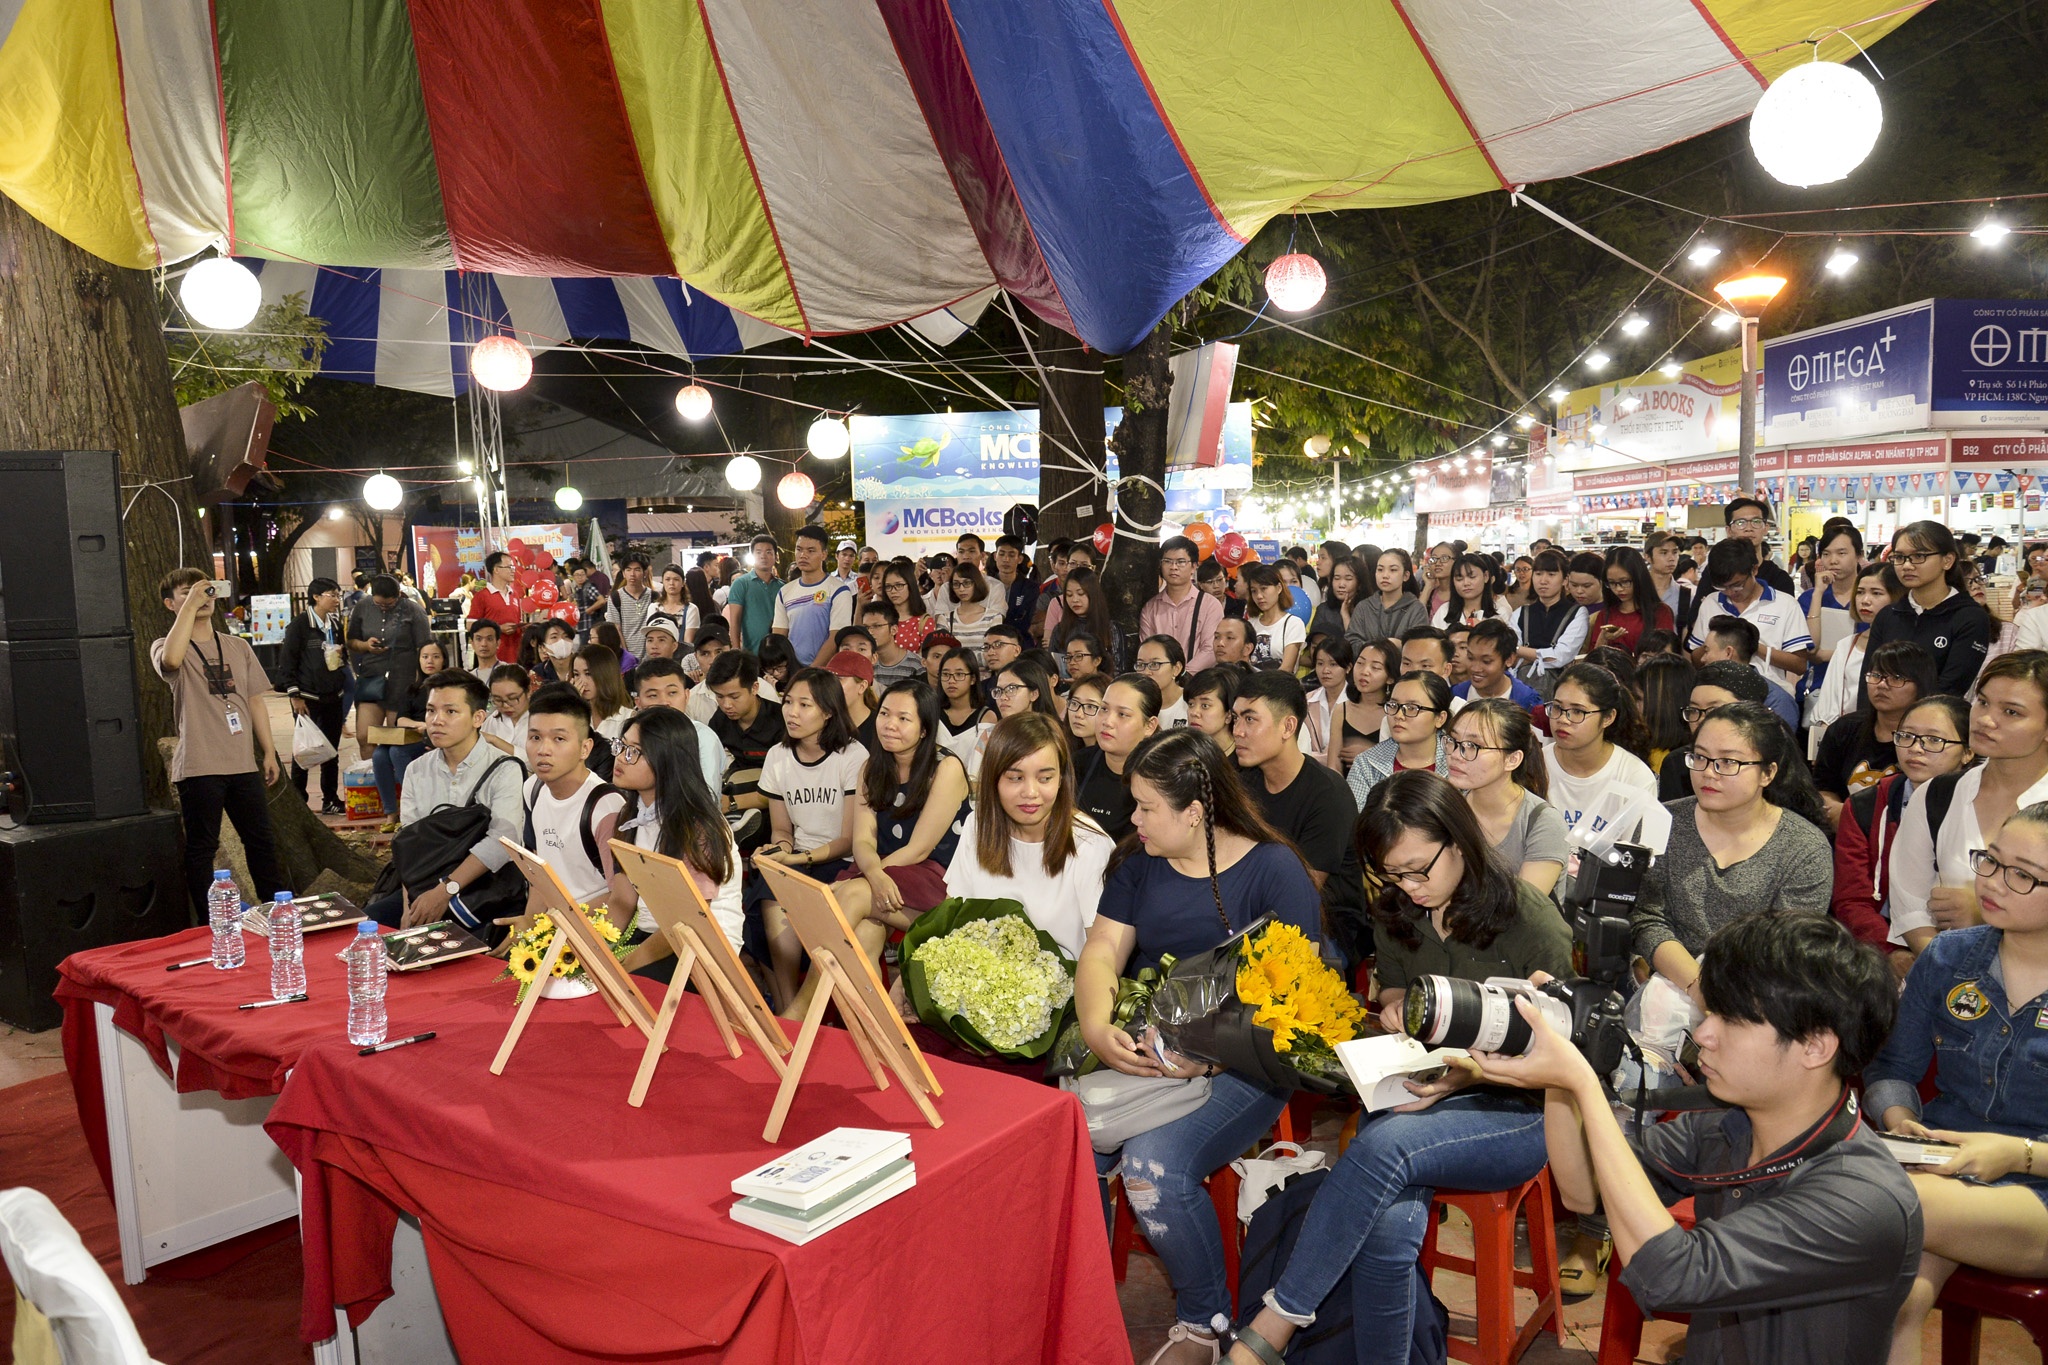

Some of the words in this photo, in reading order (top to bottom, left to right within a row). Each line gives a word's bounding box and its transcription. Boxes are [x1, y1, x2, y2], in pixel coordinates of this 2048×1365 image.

[2018, 380, 2027, 389] 14
[1652, 390, 1695, 417] BOOKS
[1964, 392, 1976, 401] VP
[1978, 392, 2004, 401] HCM:
[2006, 392, 2027, 401] 138C
[2029, 392, 2048, 404] Nguy
[1963, 445, 1979, 455] B92
[1993, 444, 2011, 455] CTY
[2013, 439, 2026, 454] CỔ
[1807, 454, 1817, 463] CTY
[1825, 449, 1838, 462] PHẦN
[1839, 450, 1853, 461] SÁCH
[1854, 450, 1871, 460] ALPHA
[1875, 450, 1885, 459] CHI
[1885, 446, 1905, 459] NHÁNH
[1906, 448, 1916, 460] TẠI
[1916, 447, 1924, 457] TP
[1924, 446, 1939, 456] HCM
[980, 461, 1039, 470] KNOWLED
[903, 507, 1002, 528] MCBooks
[503, 532, 563, 547] Snsen's
[786, 786, 837, 806] RADIANT
[1561, 985, 1573, 997] Canon
[1591, 1012, 1600, 1020] EOS
[1766, 1162, 1796, 1174] Mark
